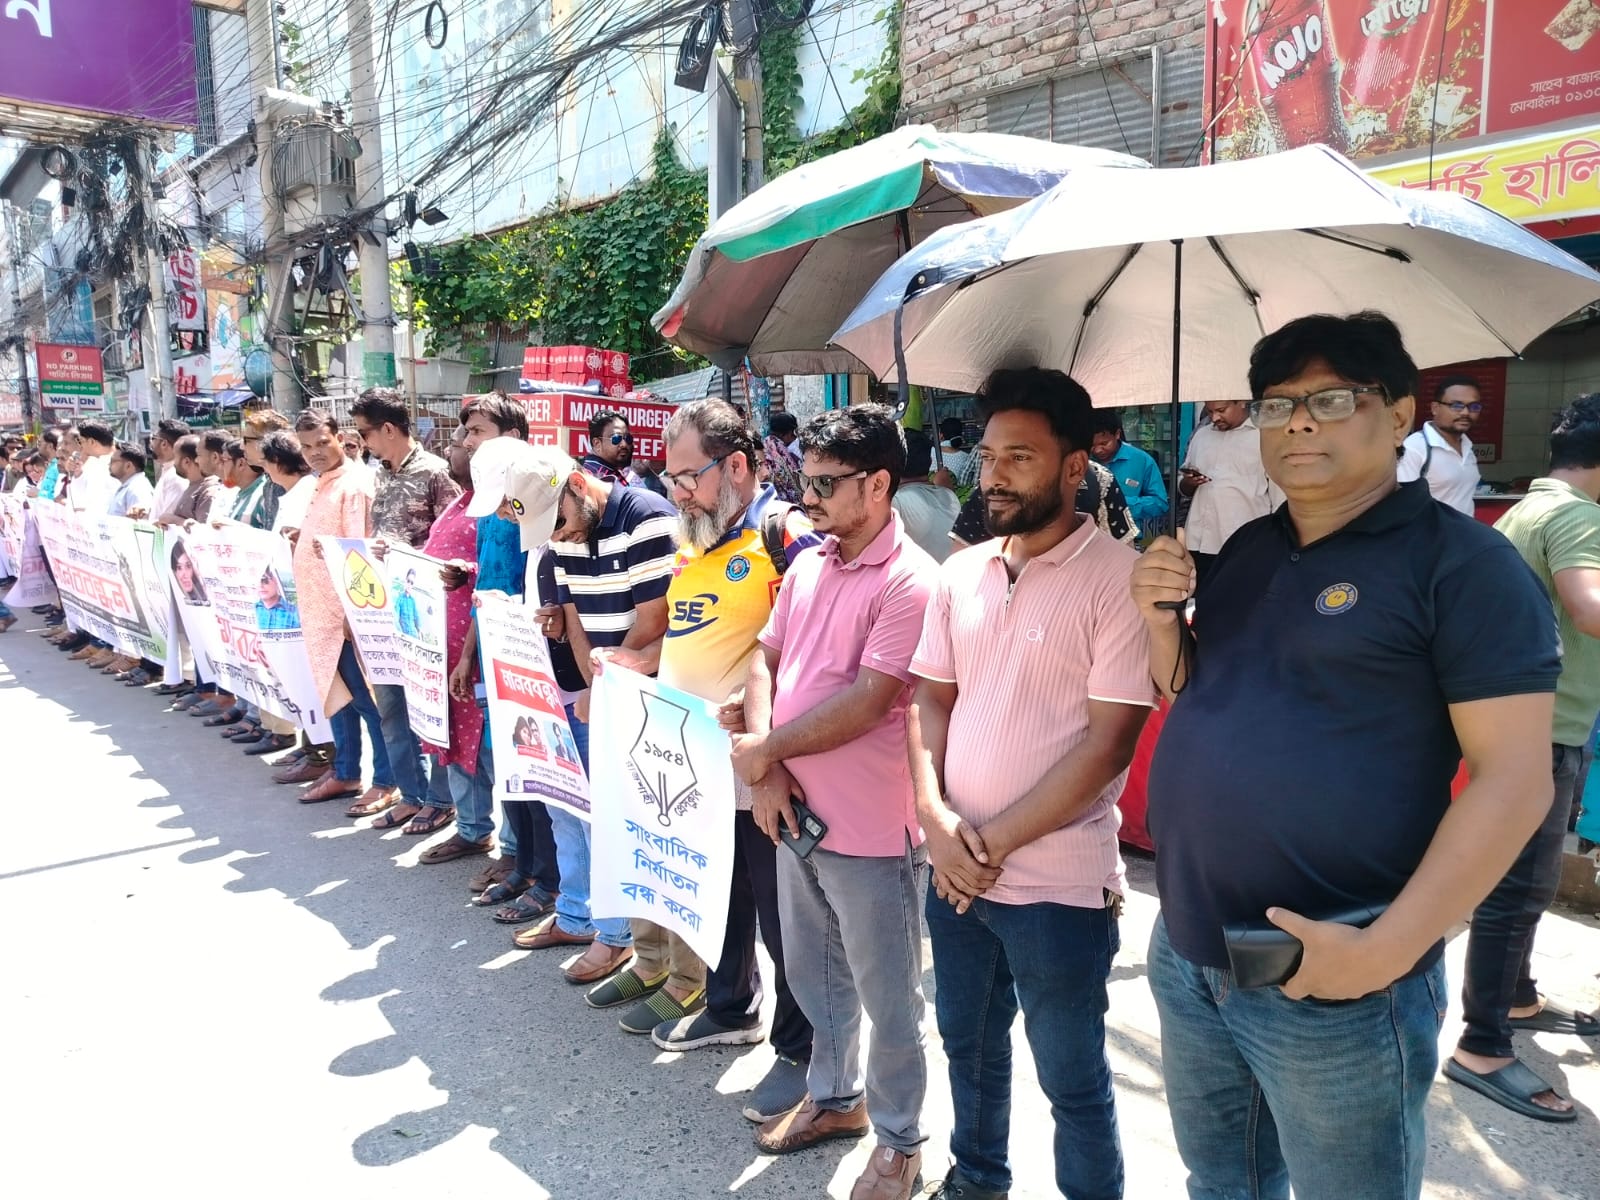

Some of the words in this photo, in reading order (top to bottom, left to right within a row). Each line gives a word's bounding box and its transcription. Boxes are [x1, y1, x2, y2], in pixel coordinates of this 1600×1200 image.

[1530, 78, 1563, 93] সাহেব
[49, 396, 96, 406] WALON
[522, 399, 551, 423] RGER
[570, 401, 614, 422] MA
[578, 434, 593, 454] N
[631, 438, 665, 457] EEF
[672, 601, 705, 624] SE
[643, 740, 685, 767] ১৯৫৪
[625, 818, 709, 871] সাংবাদিক
[632, 848, 700, 900] নির্যাতন
[620, 881, 656, 906] বন্ধ
[663, 892, 704, 935] করো
